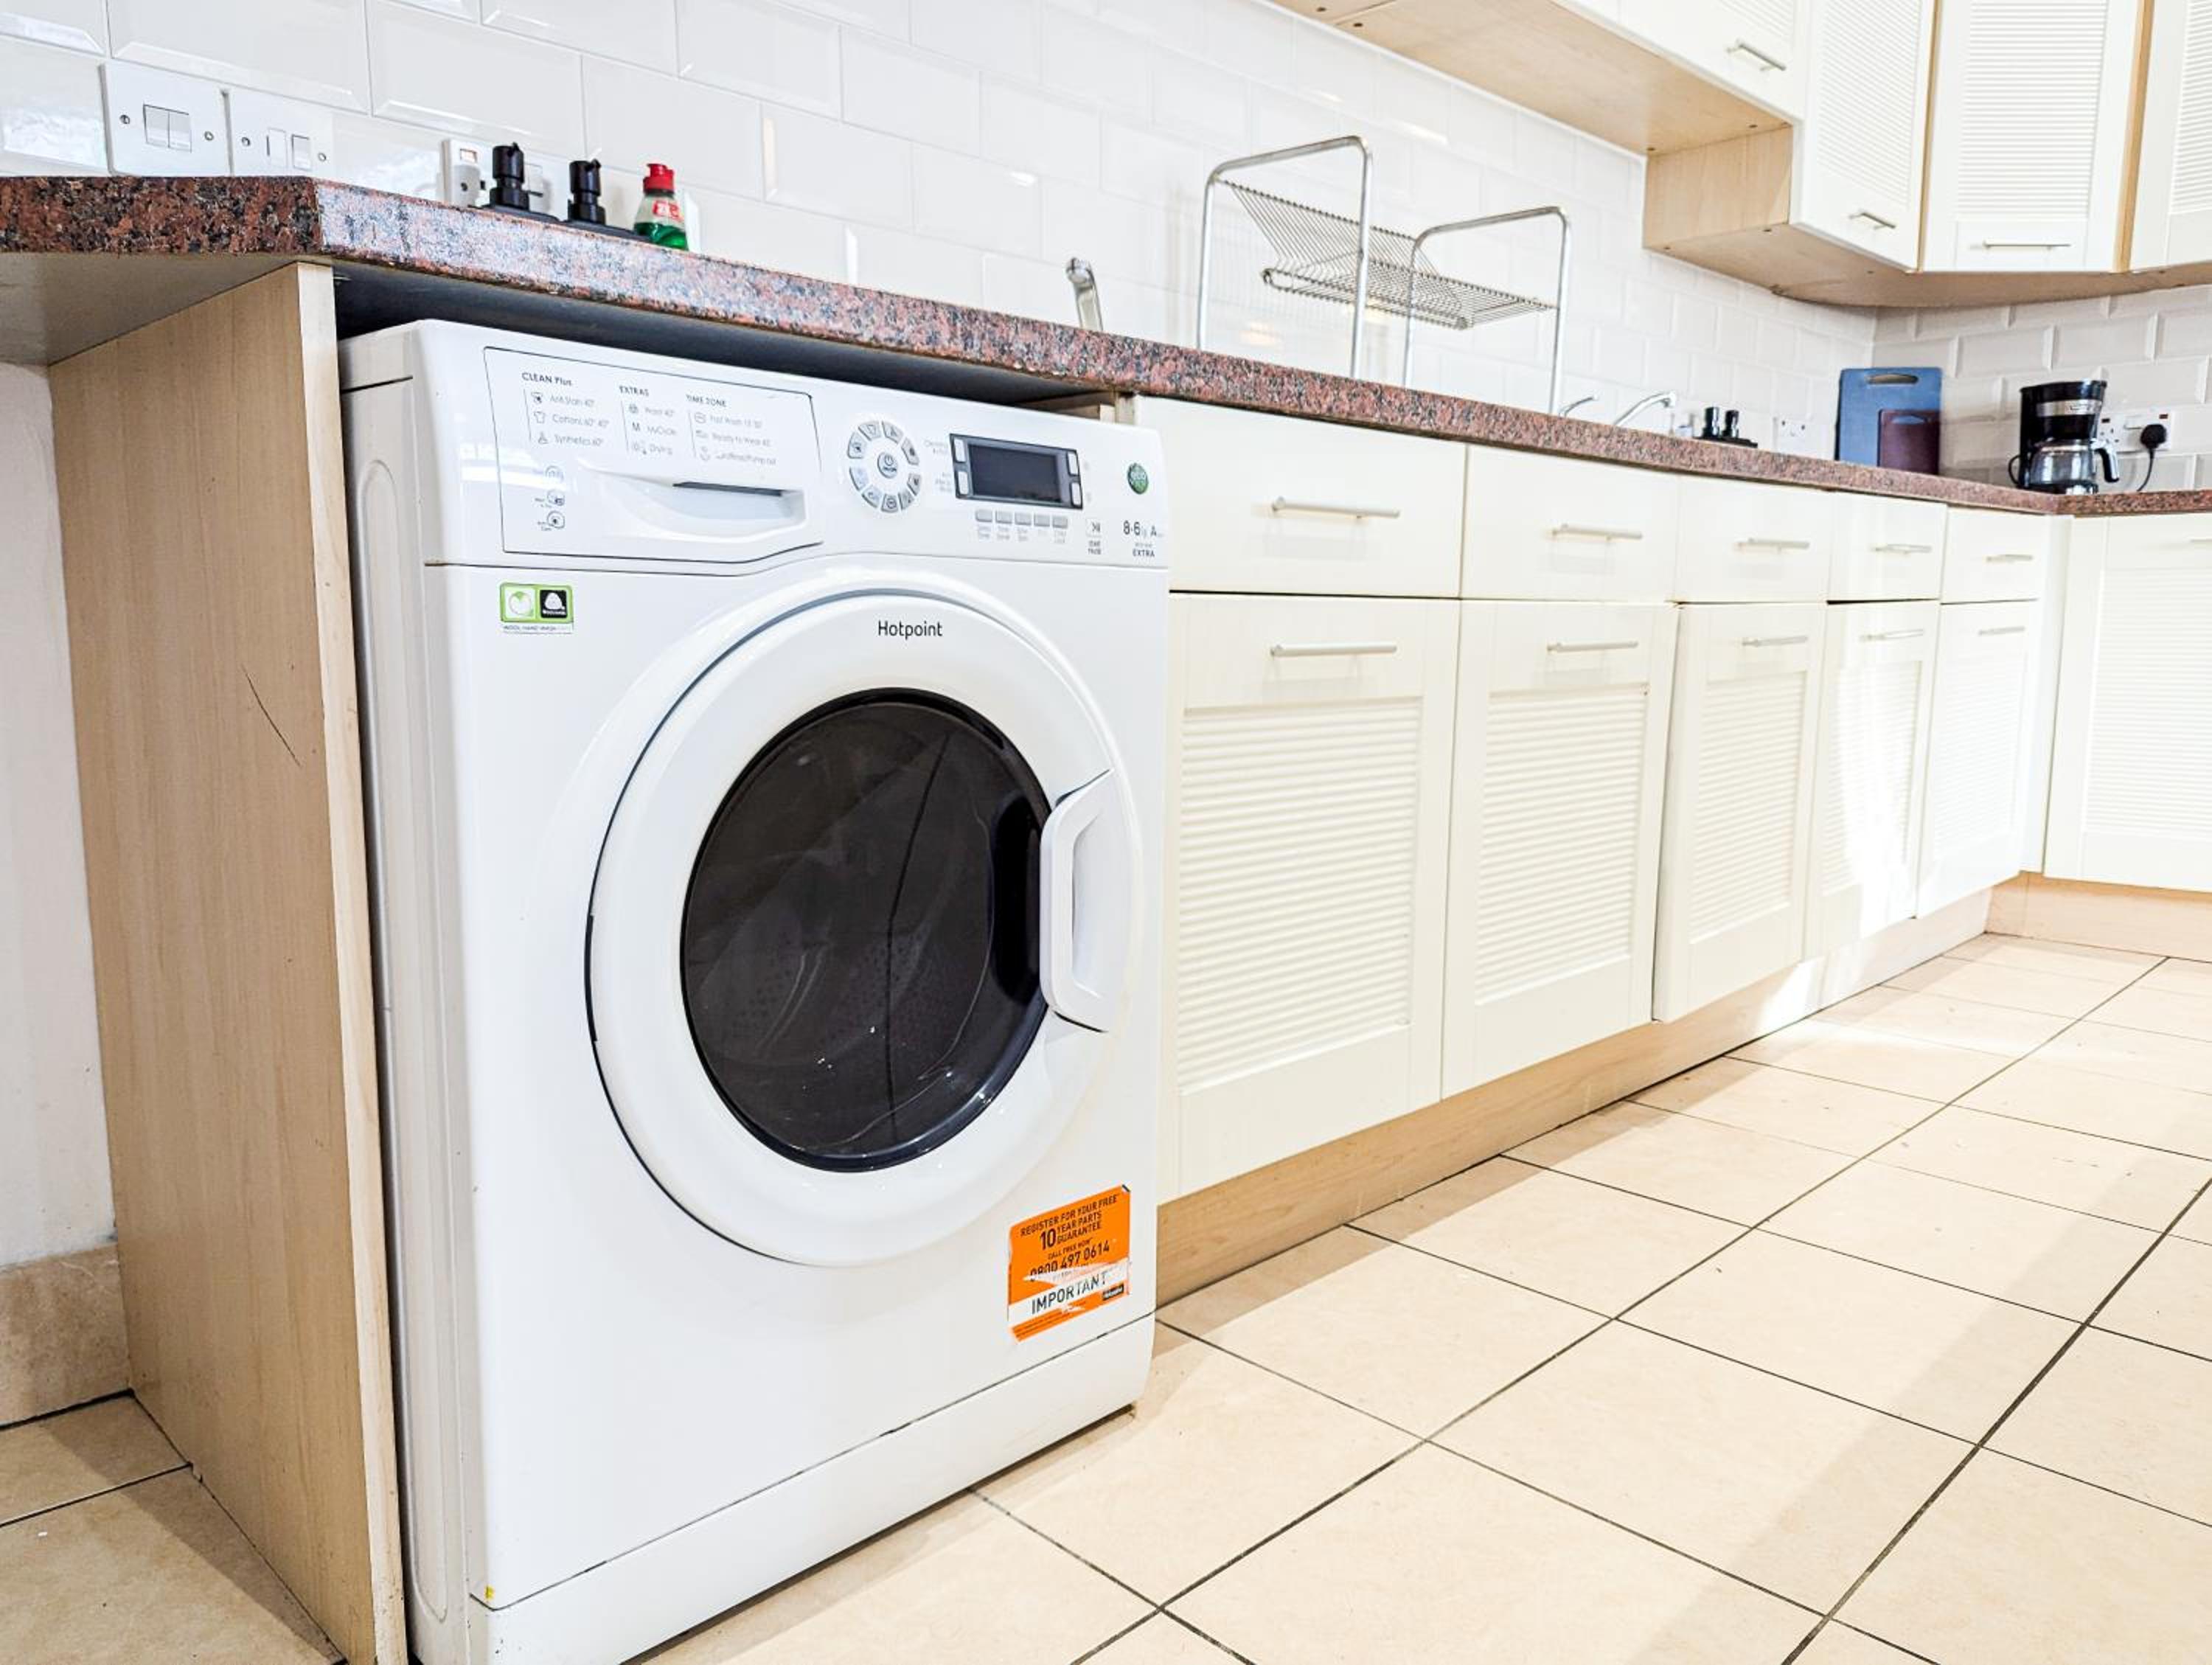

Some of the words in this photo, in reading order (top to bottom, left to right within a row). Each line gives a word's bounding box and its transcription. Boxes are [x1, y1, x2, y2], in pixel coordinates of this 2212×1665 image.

[521, 372, 552, 383] CLEAN
[1133, 549, 1155, 557] EXTRA
[878, 619, 942, 640] Hotpoint
[1020, 1216, 1060, 1237] REGISTER
[1060, 1209, 1076, 1222] FOR
[1077, 1201, 1097, 1216] YOUR
[1098, 1195, 1117, 1209] FREE
[1057, 1220, 1077, 1234] YEAR
[1078, 1210, 1102, 1226] PARTS
[1040, 1228, 1057, 1251] 10
[1057, 1221, 1102, 1245] GUARANTEE
[1060, 1251, 1081, 1270] 497
[1082, 1240, 1110, 1261] 0614
[1032, 1271, 1109, 1315] IMPORTANT
